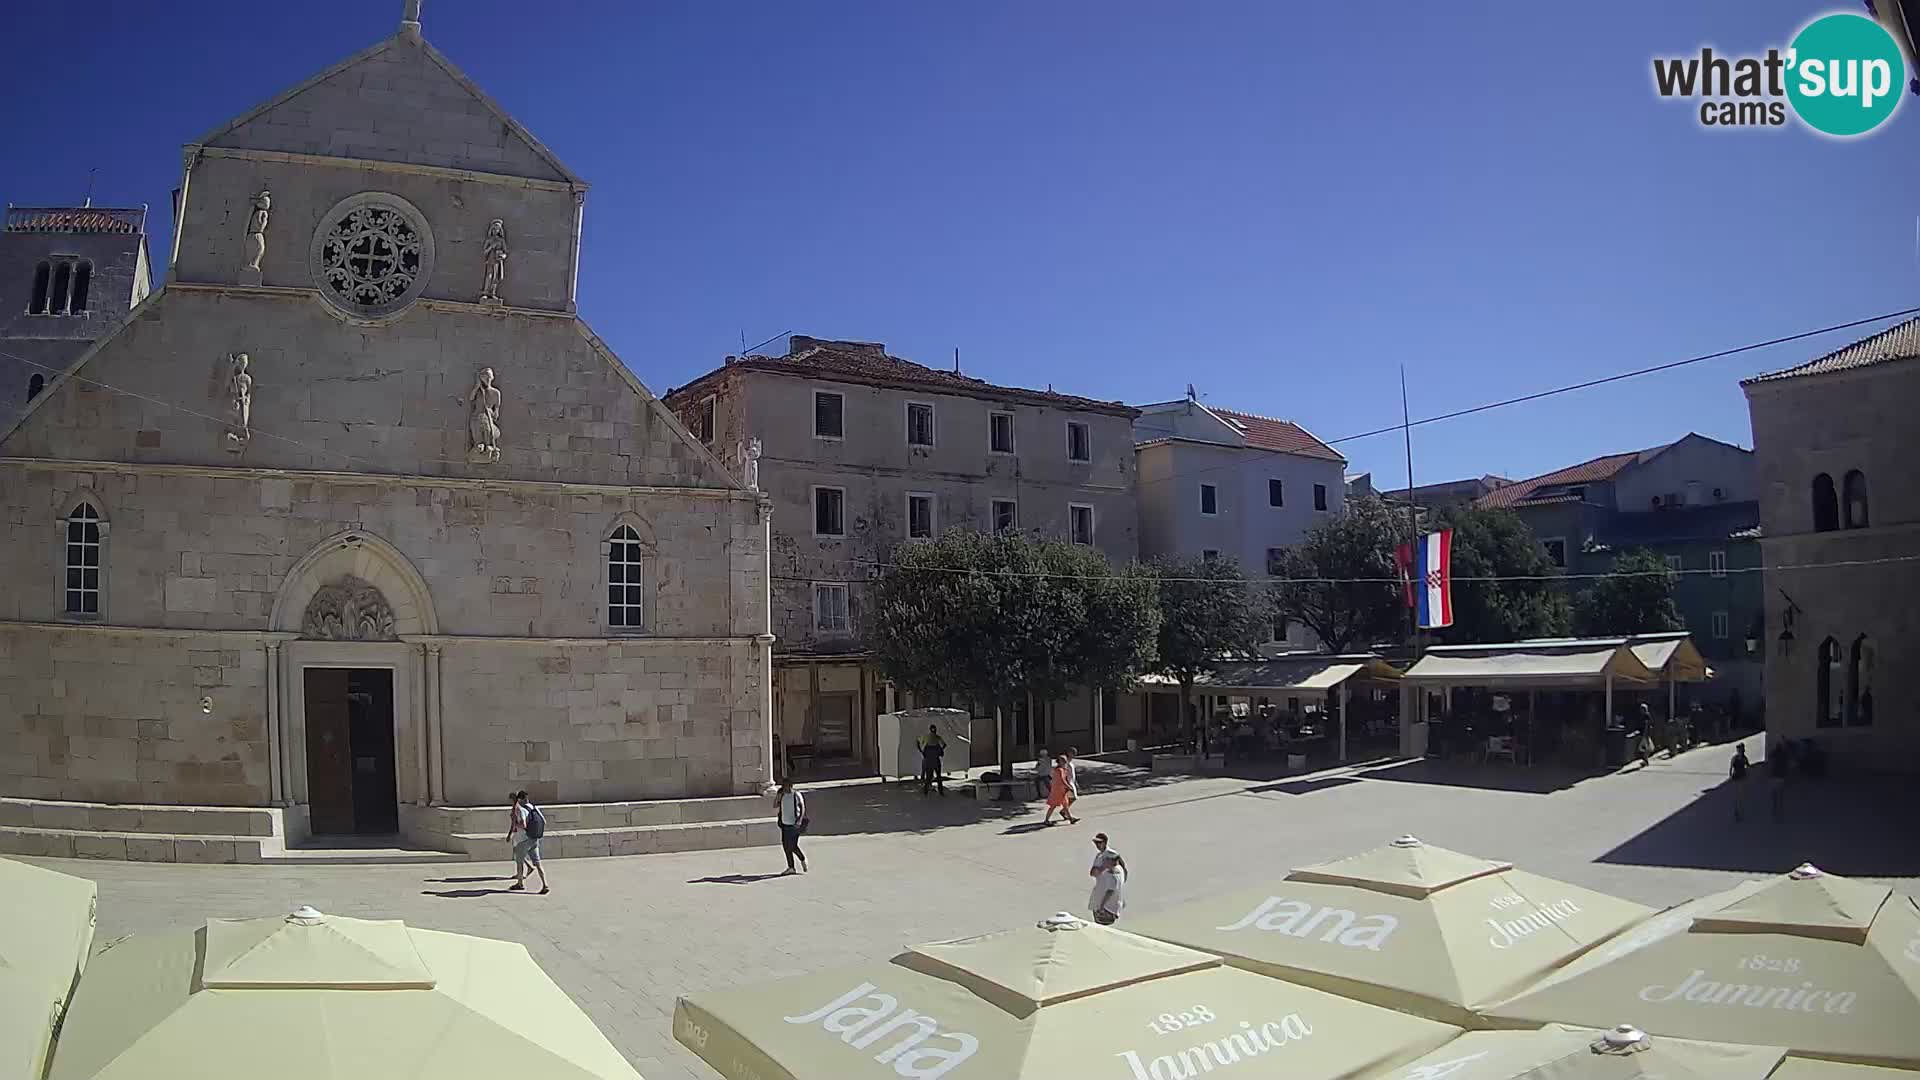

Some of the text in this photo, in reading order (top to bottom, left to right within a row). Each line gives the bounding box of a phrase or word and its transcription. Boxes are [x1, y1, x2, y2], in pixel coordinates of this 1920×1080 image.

[1216, 896, 1399, 951] Jana
[1488, 899, 1580, 949] Jamnica
[1737, 954, 1801, 973] 1828
[1639, 969, 1856, 1013] Jamnica
[784, 982, 979, 1080] Jana
[1146, 1004, 1215, 1034] 1828
[1114, 1009, 1313, 1080] Jamnica
